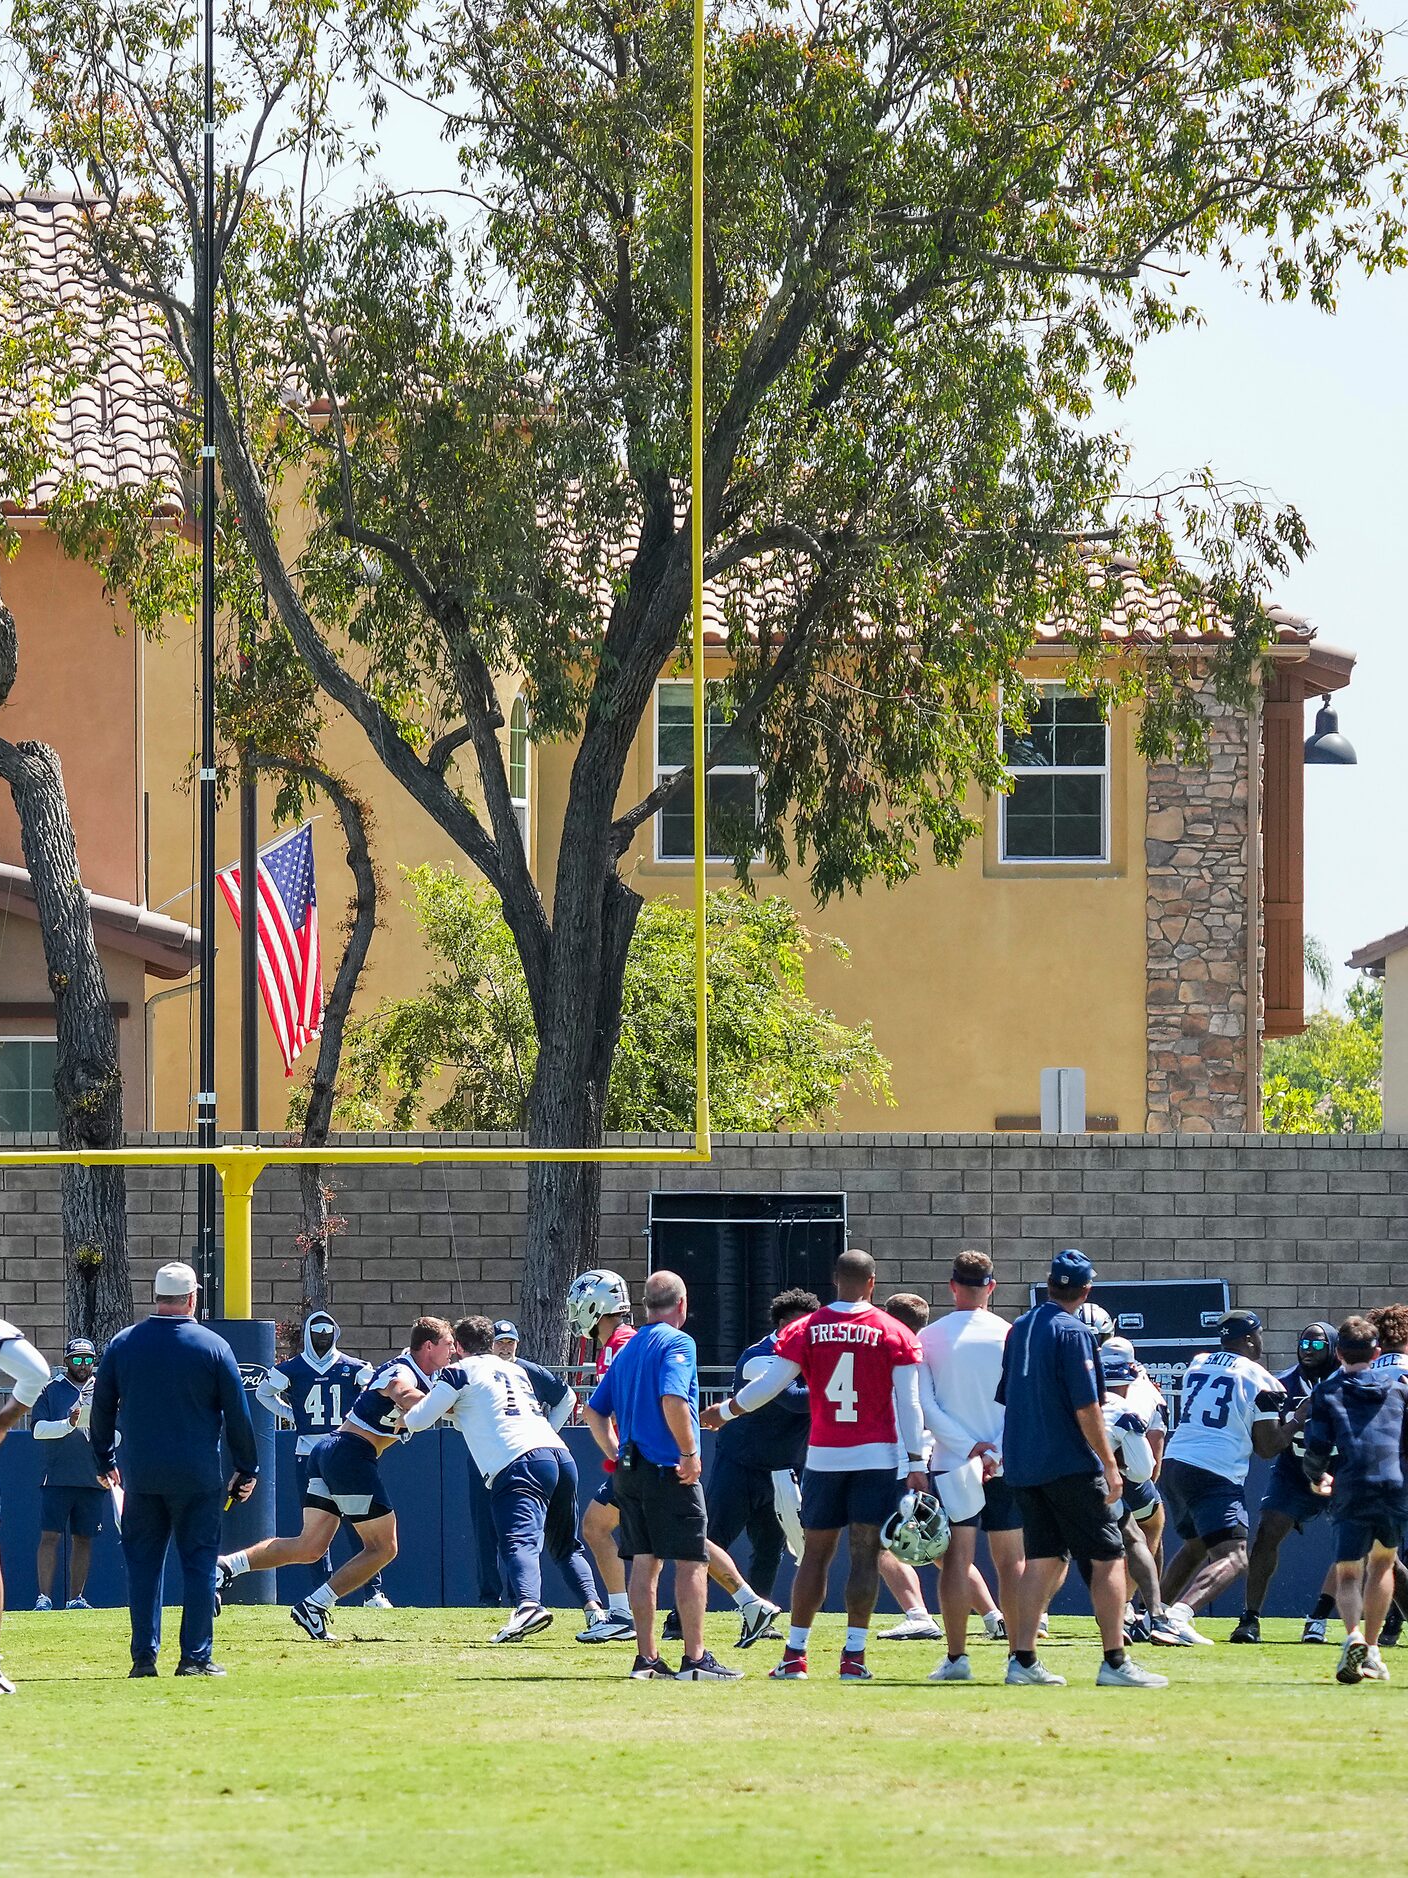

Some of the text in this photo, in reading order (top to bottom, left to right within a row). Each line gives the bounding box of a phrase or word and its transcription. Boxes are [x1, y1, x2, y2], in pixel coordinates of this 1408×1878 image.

[810, 1322, 883, 1347] PRESCOTT
[304, 1384, 343, 1426] 41
[824, 1352, 858, 1422] 4
[1180, 1372, 1235, 1430] 73
